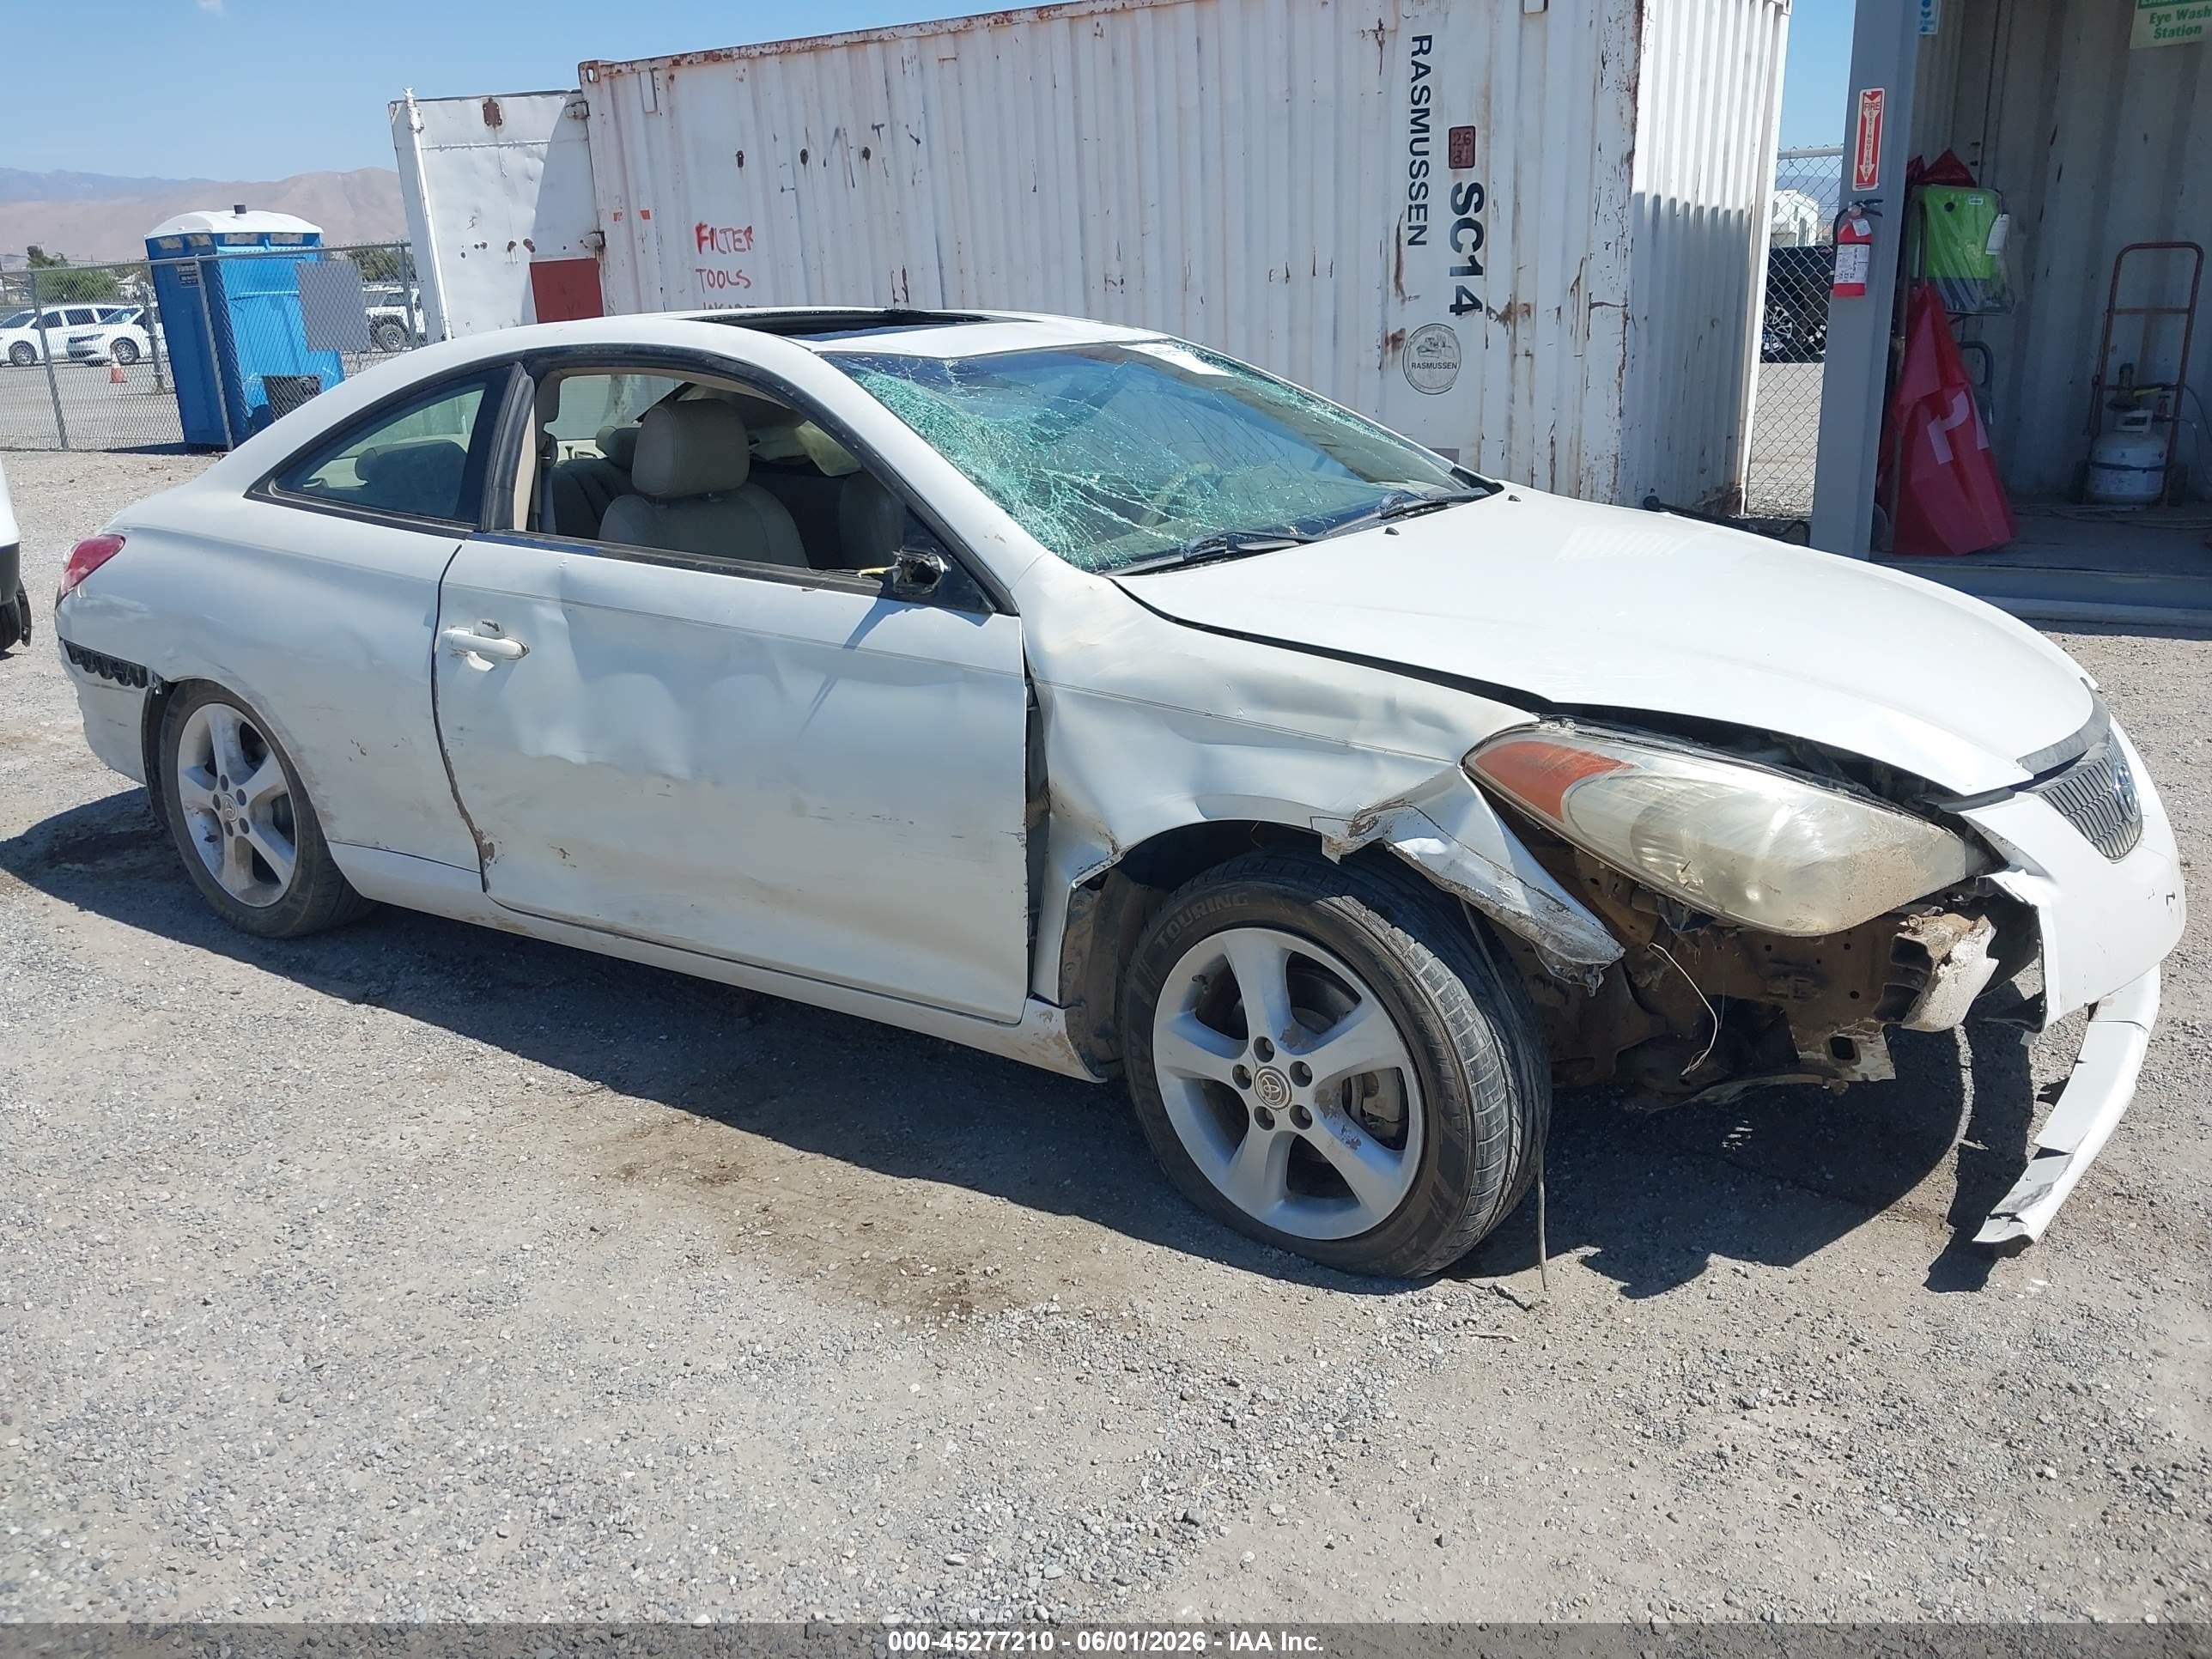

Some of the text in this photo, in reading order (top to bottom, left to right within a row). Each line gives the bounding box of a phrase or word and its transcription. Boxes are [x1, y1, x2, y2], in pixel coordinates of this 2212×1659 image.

[2149, 5, 2212, 27] Eye Wash
[2153, 24, 2203, 40] Station
[1863, 101, 1881, 112] FIRE
[1407, 33, 1433, 246] RASMUSSEN
[1863, 110, 1875, 178] EXTINGUISHER
[694, 222, 754, 255] FILTER
[1449, 181, 1486, 317] SC14
[695, 268, 752, 295] TOOLS
[1411, 362, 1458, 370] RASMUSSEN
[1154, 892, 1250, 949] TOURING
